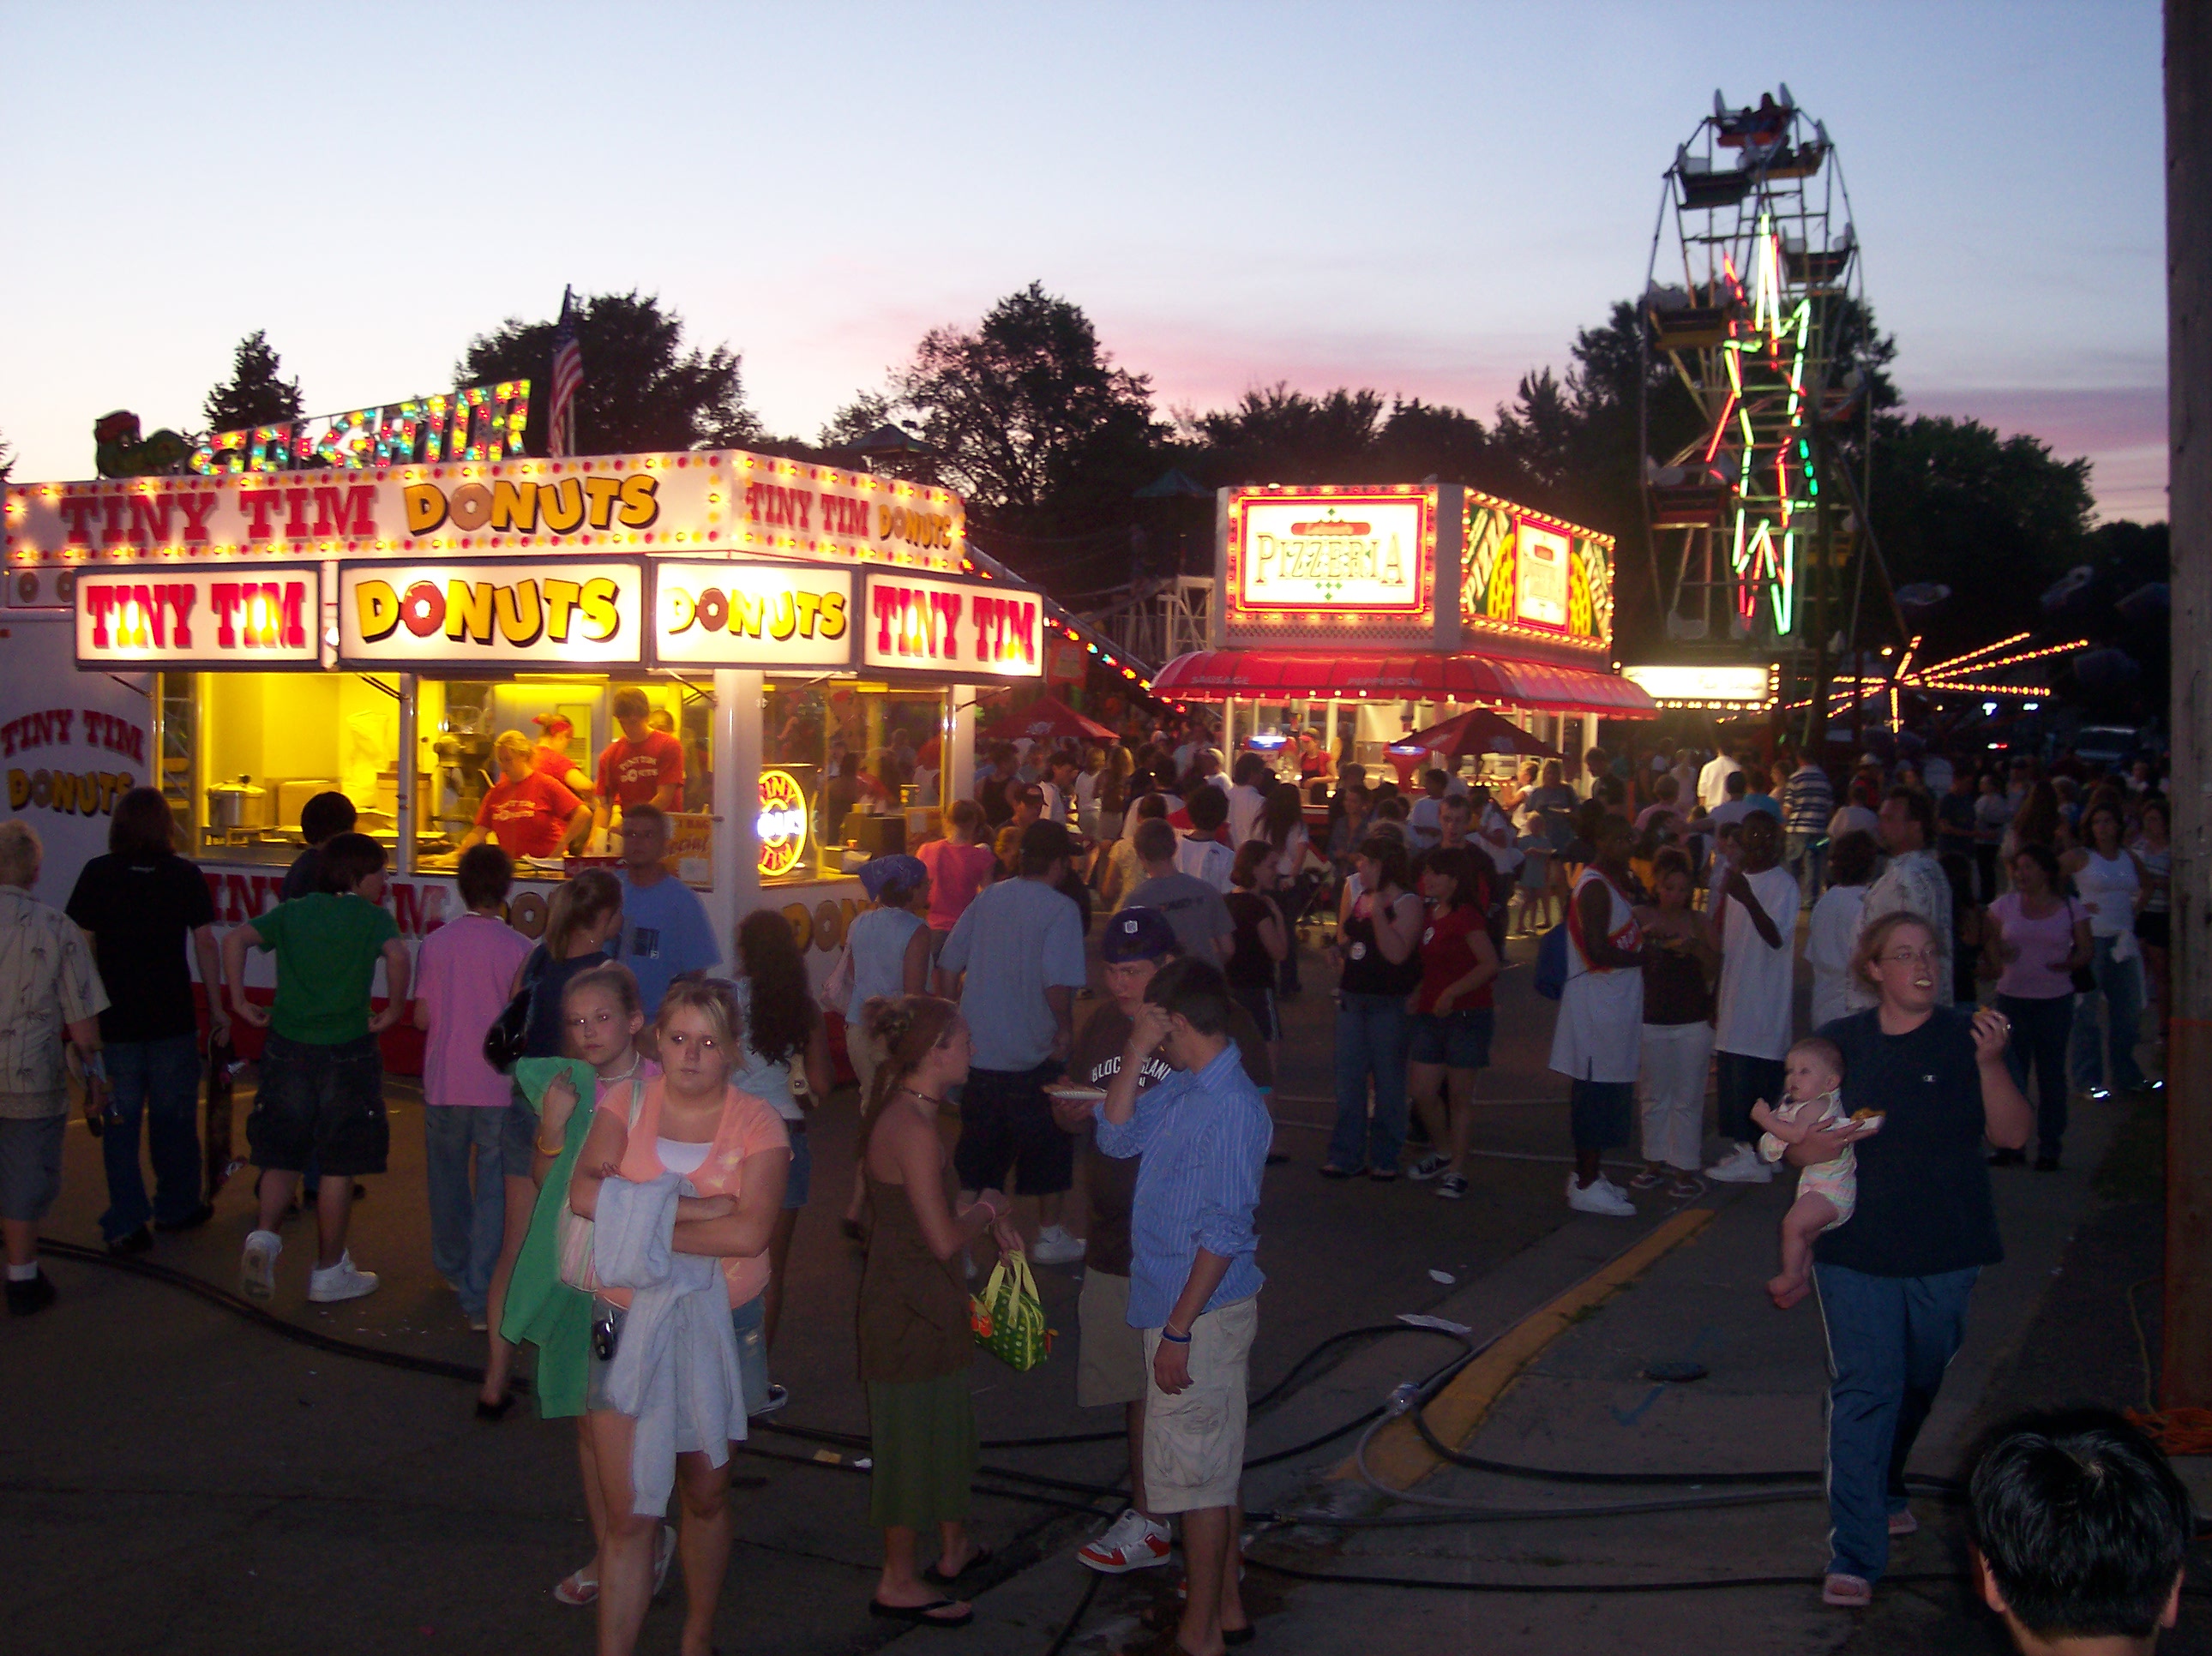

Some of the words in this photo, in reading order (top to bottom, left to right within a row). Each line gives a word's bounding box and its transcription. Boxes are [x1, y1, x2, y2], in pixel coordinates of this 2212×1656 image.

[60, 491, 219, 545] TINY
[239, 485, 380, 542] TIM
[403, 474, 660, 536] DONUTS
[748, 482, 813, 532] TINY
[820, 494, 870, 541] TIM
[879, 504, 953, 550] DONUTS
[1253, 532, 1406, 587] PIZZERIA
[87, 584, 196, 649] TINY
[212, 582, 306, 649] TIM
[355, 578, 620, 648] DONUTS
[663, 586, 847, 642] DONUTS
[874, 585, 963, 659] TINY
[972, 595, 1036, 665] TIM
[1, 709, 74, 759] TINY
[83, 710, 145, 767] TIM
